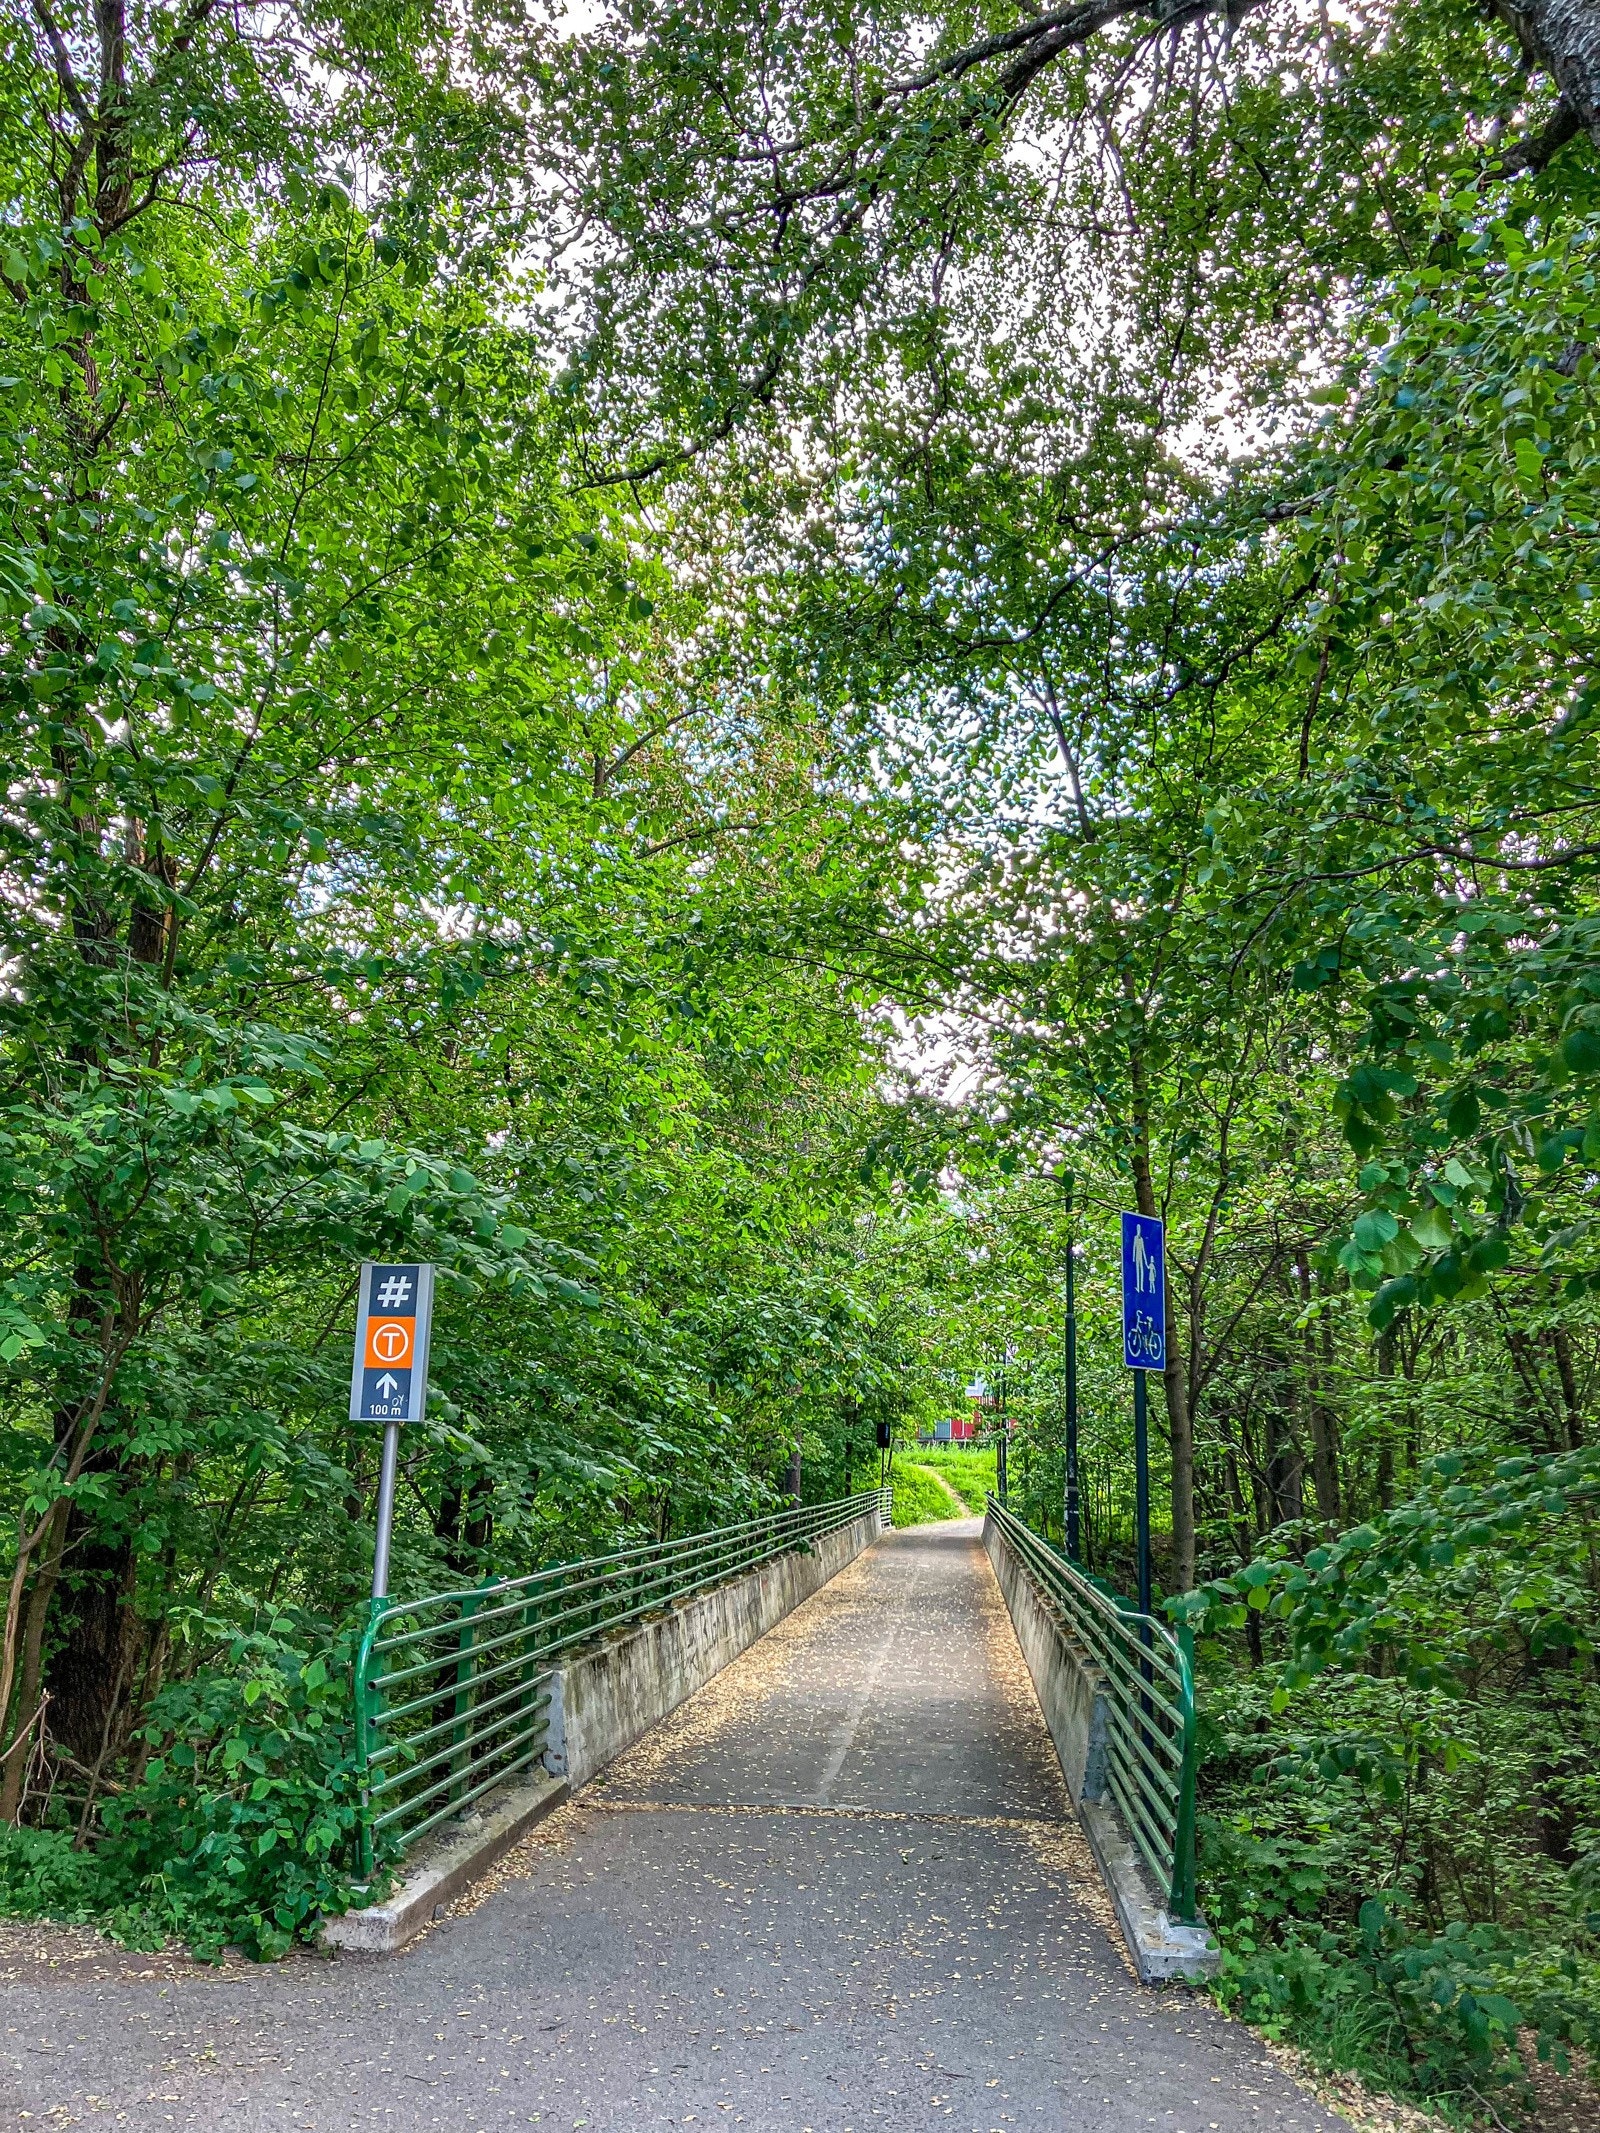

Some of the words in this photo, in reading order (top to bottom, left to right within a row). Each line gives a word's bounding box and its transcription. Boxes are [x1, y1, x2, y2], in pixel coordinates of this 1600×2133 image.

[382, 1332, 400, 1357] T
[370, 1404, 388, 1415] 100
[391, 1407, 401, 1415] m
